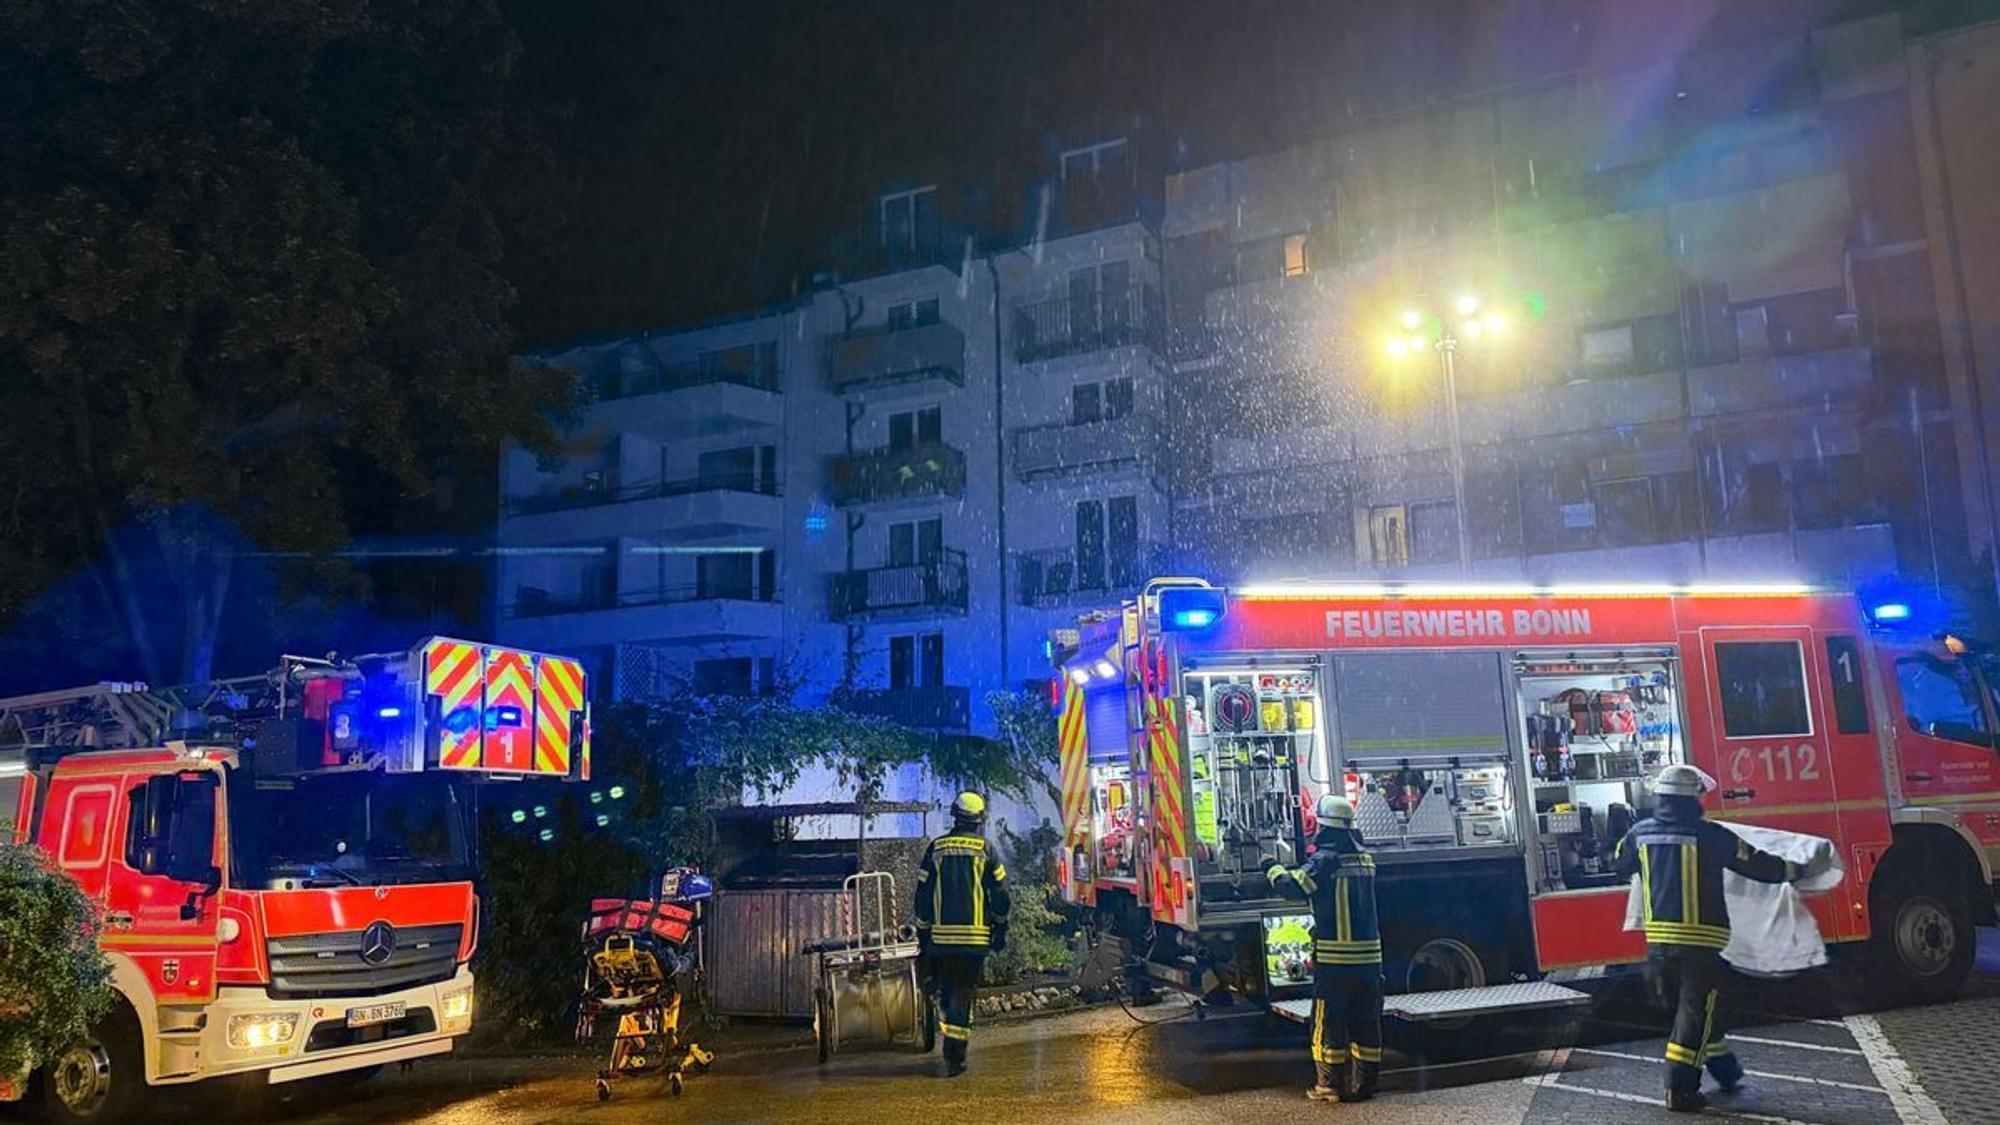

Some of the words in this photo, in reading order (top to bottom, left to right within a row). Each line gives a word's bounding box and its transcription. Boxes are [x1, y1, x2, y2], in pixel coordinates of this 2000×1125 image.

[1325, 611, 1506, 638] FEUERWEHR
[1511, 609, 1592, 635] BONN
[1838, 651, 1853, 683] 1
[501, 731, 513, 763] 1
[1758, 744, 1820, 782] 112
